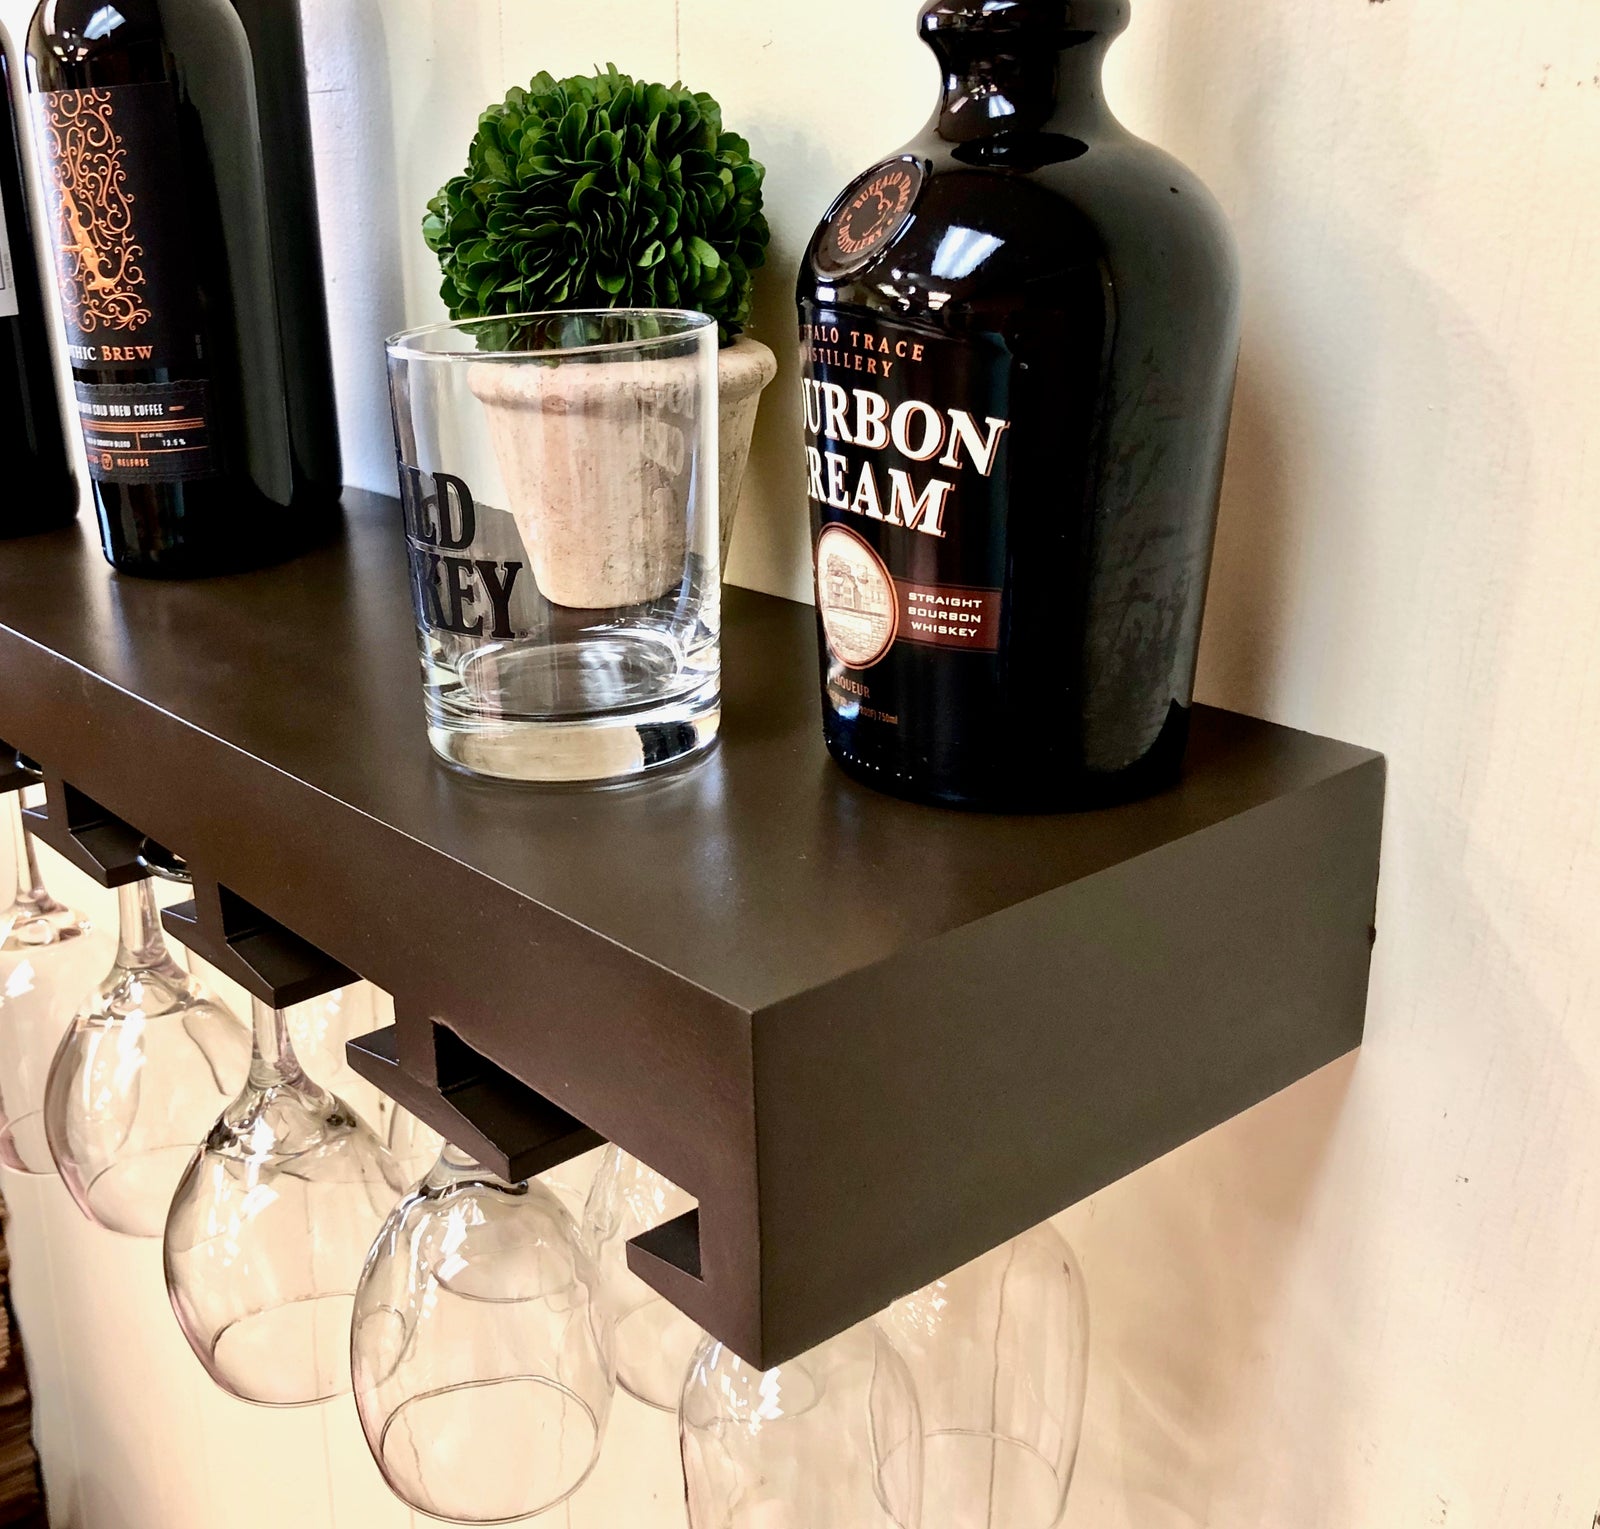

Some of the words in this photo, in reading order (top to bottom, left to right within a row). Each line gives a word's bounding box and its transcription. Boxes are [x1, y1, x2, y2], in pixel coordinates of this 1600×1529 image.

[853, 171, 903, 209] BUFFALO
[837, 223, 883, 254] DISTILLERY
[101, 345, 153, 361] BREW
[850, 331, 924, 361] TRACE
[93, 404, 108, 416] COLD
[110, 405, 131, 416] BREW
[133, 404, 163, 416] COFFEE
[801, 377, 1010, 477] URBON
[117, 458, 150, 467] RELEASE
[805, 445, 955, 538] REAM
[908, 592, 982, 608] STRAIGHT
[908, 606, 981, 623] BOURBON
[911, 621, 977, 637] WHISKEY
[834, 674, 870, 698] LIQUEUR
